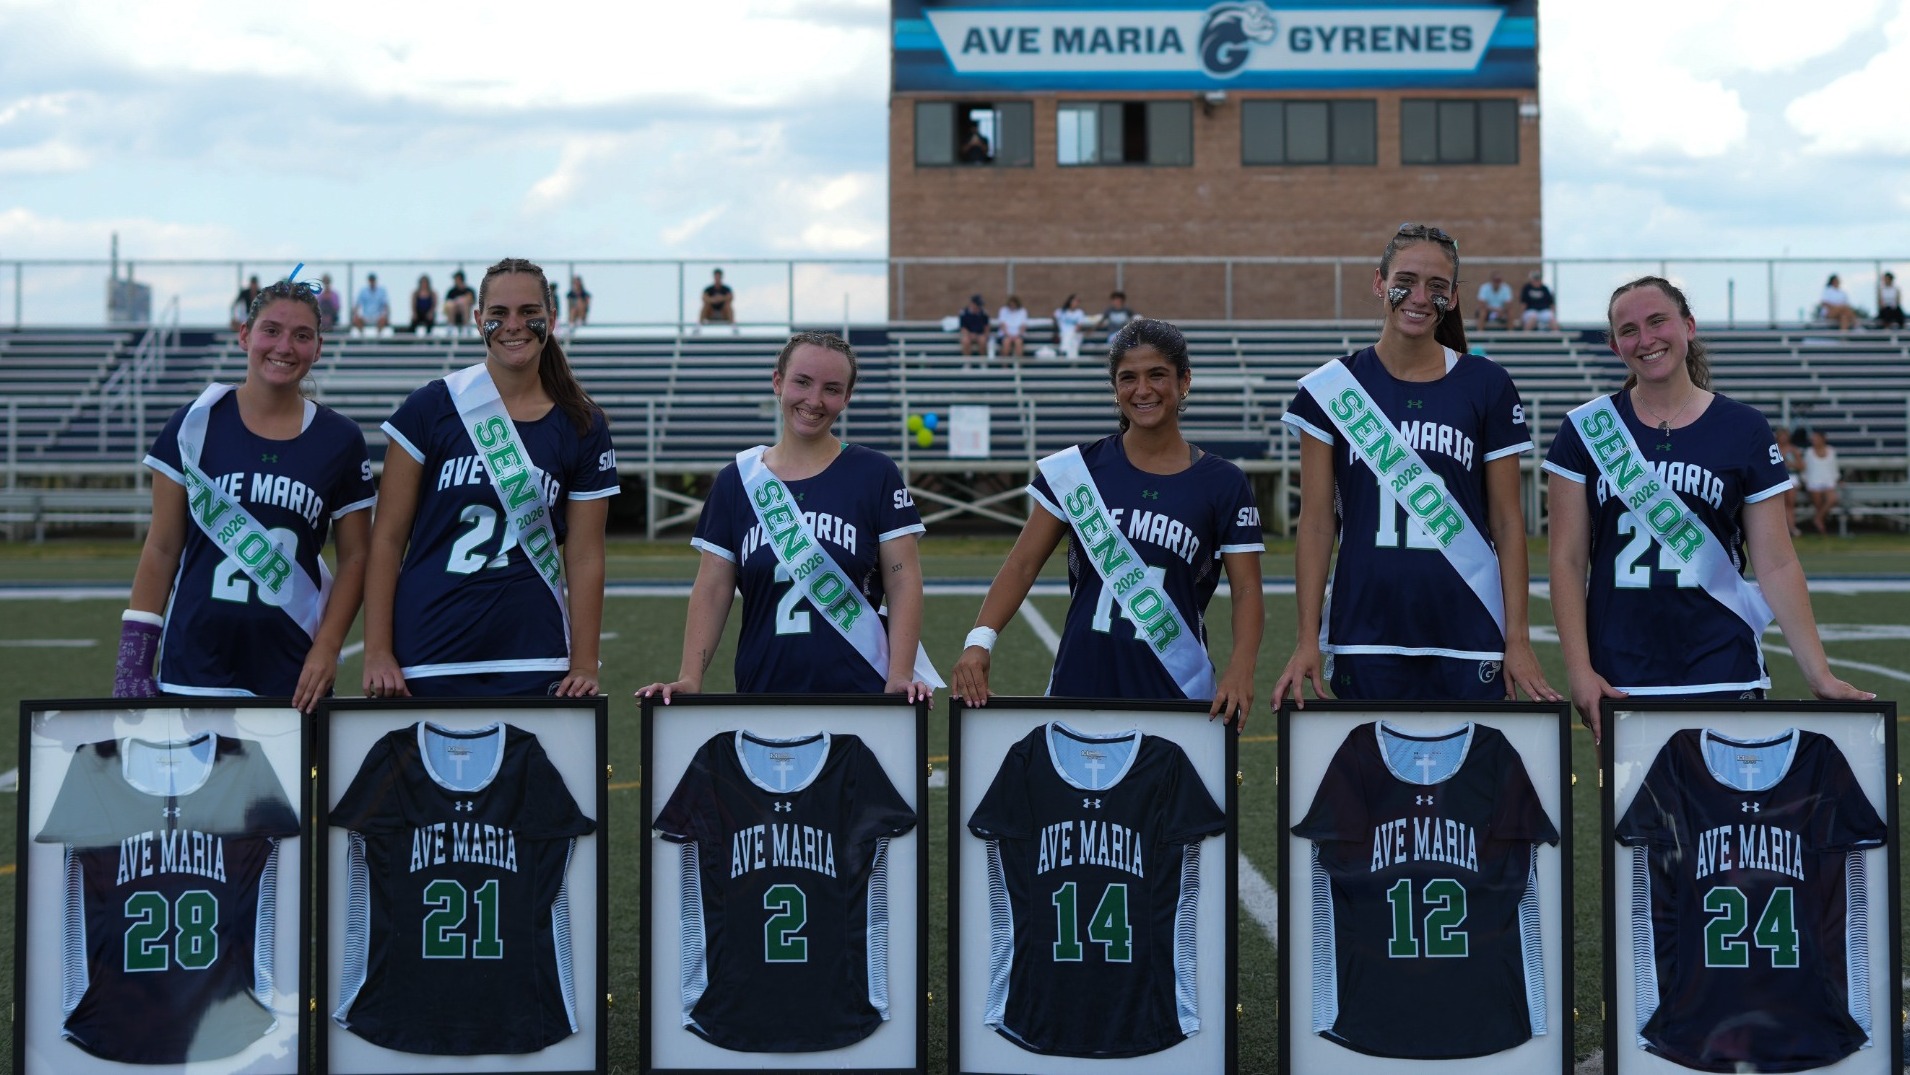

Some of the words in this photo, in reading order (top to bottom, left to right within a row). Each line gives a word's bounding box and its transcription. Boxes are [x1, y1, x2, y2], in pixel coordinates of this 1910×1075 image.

[961, 26, 1041, 54] AVE
[1052, 26, 1185, 54] MARIA
[1288, 25, 1473, 53] GYRENES
[437, 455, 486, 491] AVE
[1400, 420, 1474, 472] MARIA
[251, 472, 323, 529] MARIA
[1390, 463, 1422, 493] 2026
[1628, 480, 1660, 510] 2026
[1648, 461, 1724, 510] MARIA
[217, 513, 247, 544] 2026
[516, 506, 544, 530] 2026
[804, 511, 856, 556] ARIA
[1128, 509, 1200, 565] MARIA
[794, 553, 825, 581] 2026
[1113, 567, 1145, 597] 2026
[774, 561, 811, 636] 2
[1091, 564, 1167, 642] 1
[116, 831, 153, 886] AVE
[159, 829, 227, 883] MARIA
[409, 823, 446, 873] AVE
[452, 821, 518, 873] MARIA
[730, 824, 766, 879] AVE
[771, 823, 837, 879] MARIA
[1037, 822, 1074, 875] AVE
[1078, 820, 1144, 879] MARIA
[1370, 819, 1408, 873] AVE
[1413, 816, 1479, 873] MARIA
[1696, 825, 1733, 882] AVE
[1738, 824, 1805, 882] MARIA
[123, 890, 219, 973] 28
[422, 879, 503, 960] 21
[763, 884, 808, 964] 2
[1051, 881, 1133, 963] 14
[1386, 878, 1469, 959] 12
[1703, 886, 1800, 969] 24
